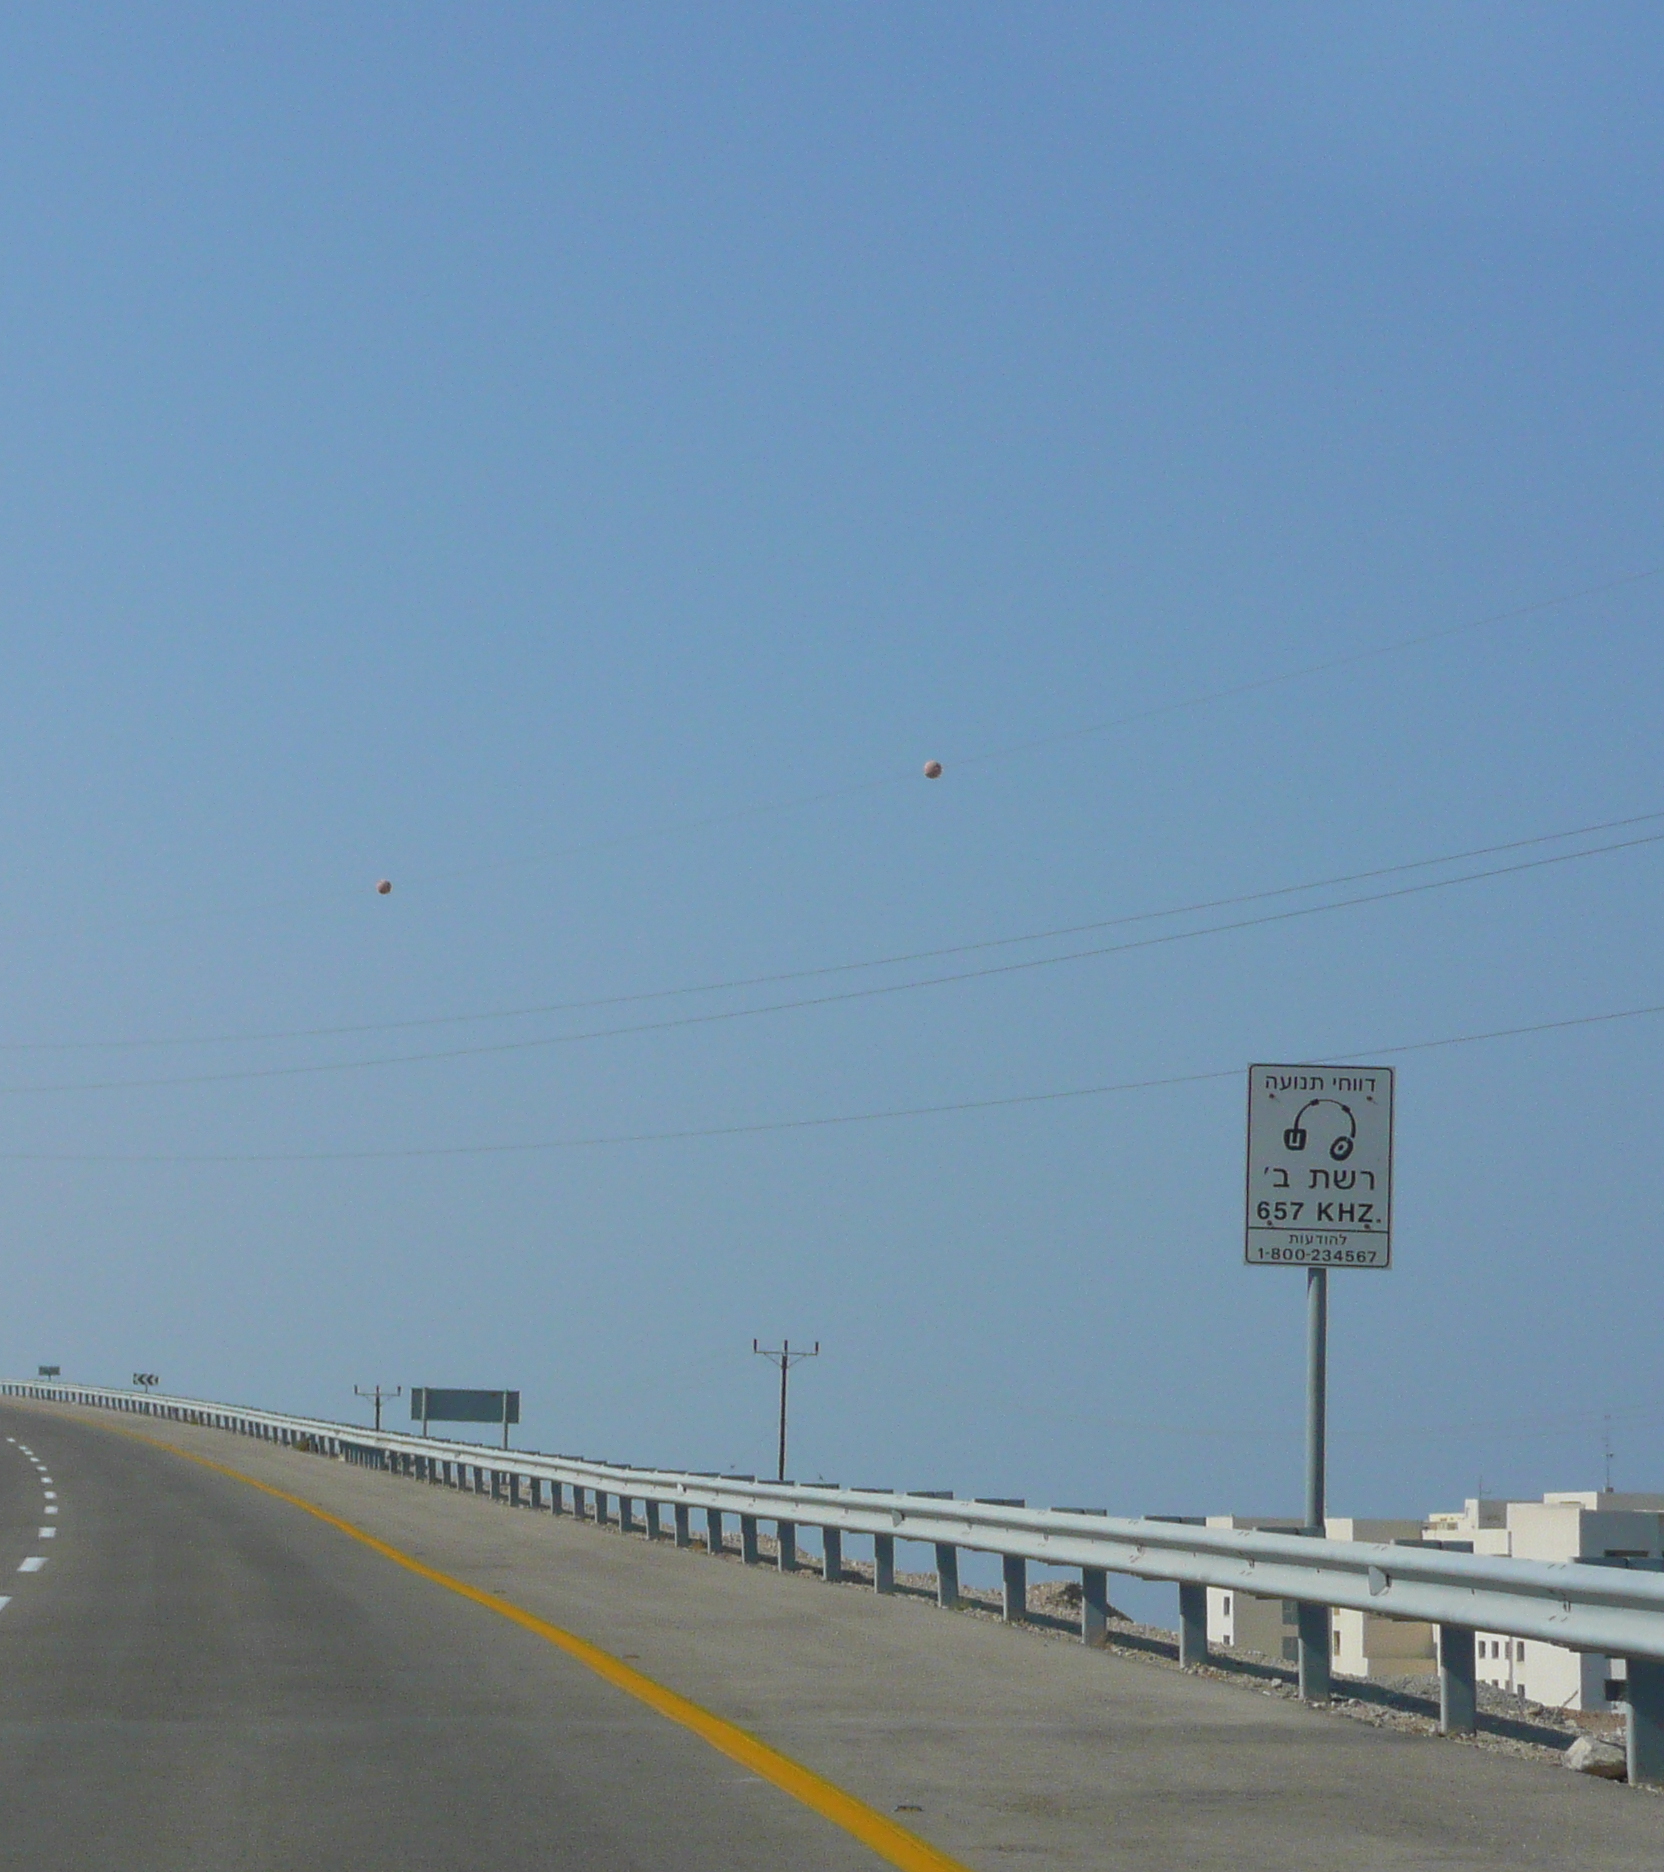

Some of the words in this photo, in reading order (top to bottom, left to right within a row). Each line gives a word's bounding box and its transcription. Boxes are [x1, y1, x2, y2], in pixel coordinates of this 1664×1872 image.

[1265, 1075, 1324, 1091] תנועה
[1332, 1077, 1376, 1092] דווחי
[1308, 1168, 1375, 1191] רשת
[1256, 1201, 1305, 1221] 657
[1317, 1202, 1382, 1223] KHZ.
[1288, 1233, 1347, 1246] להודעות
[1257, 1247, 1377, 1263] 1-800-234567
